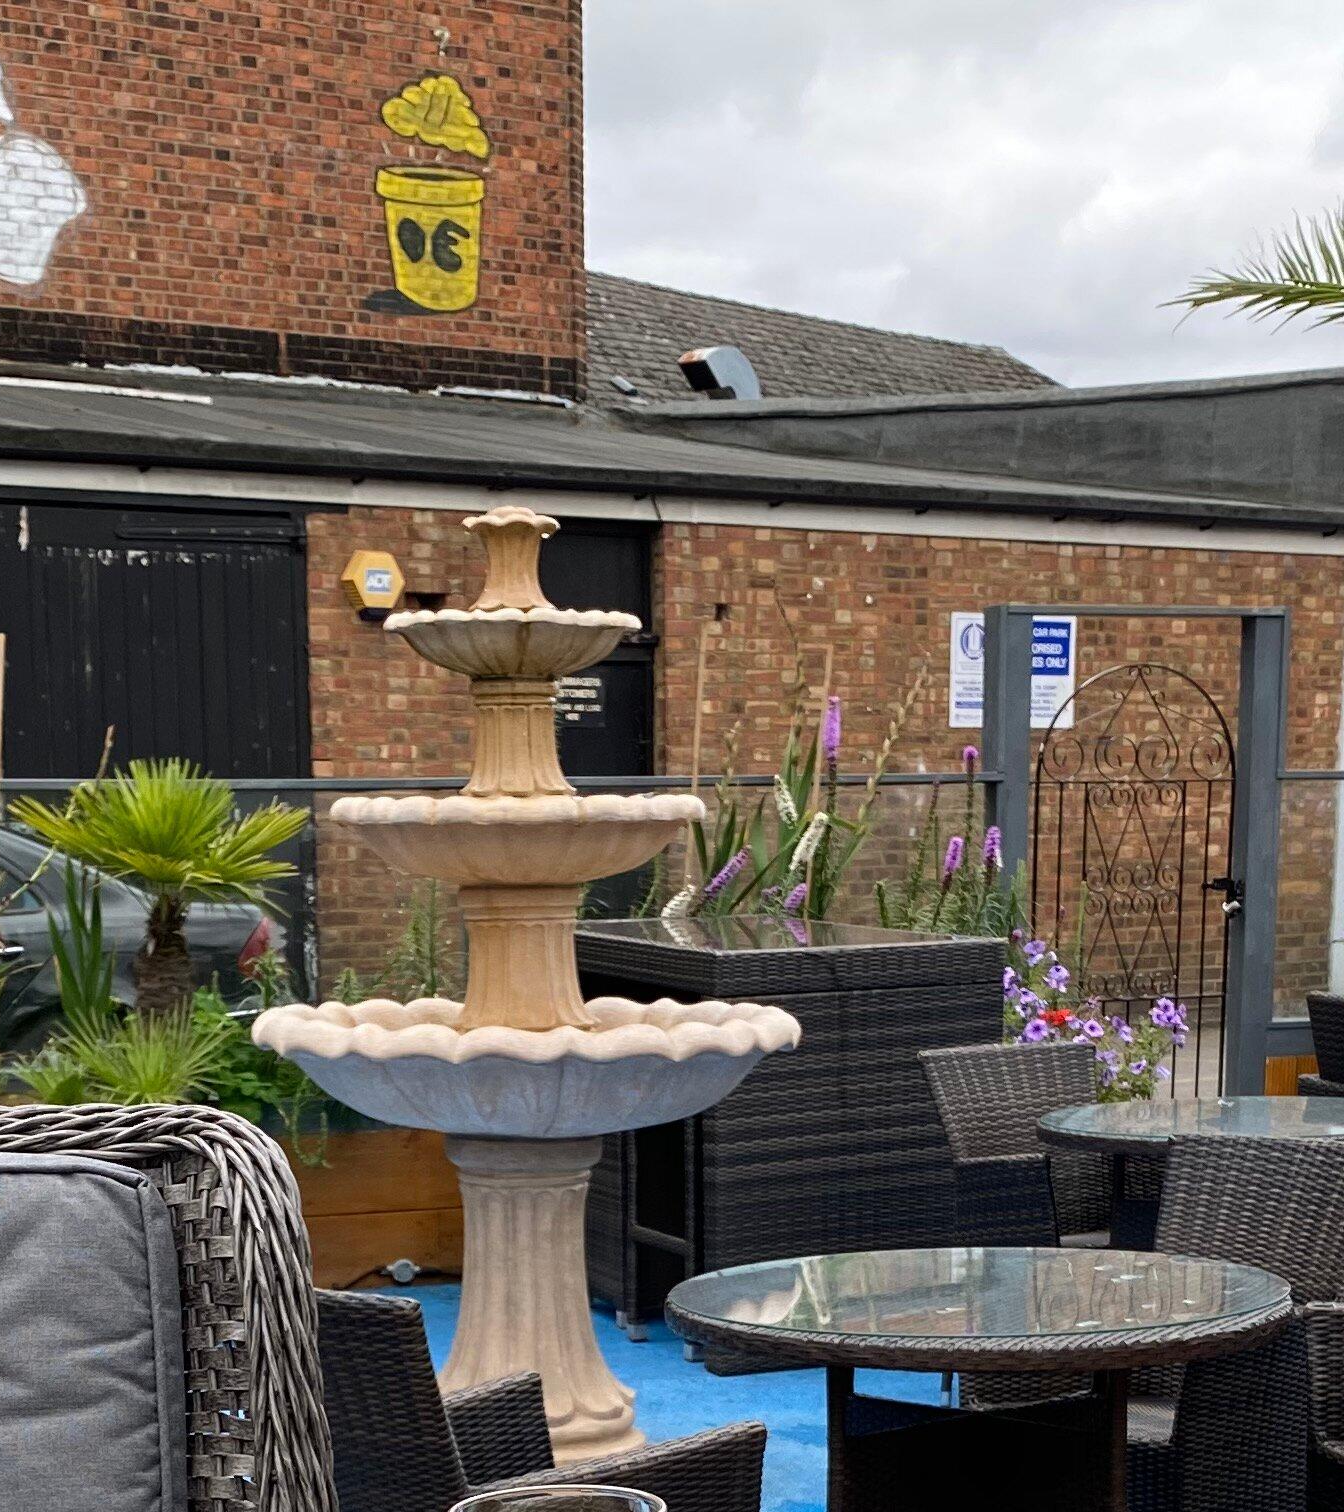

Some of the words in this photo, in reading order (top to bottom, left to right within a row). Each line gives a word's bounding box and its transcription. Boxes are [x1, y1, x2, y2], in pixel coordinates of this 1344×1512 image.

[1033, 628, 1048, 638] CAR
[1049, 628, 1068, 638] PARK
[1046, 657, 1068, 668] ONLY
